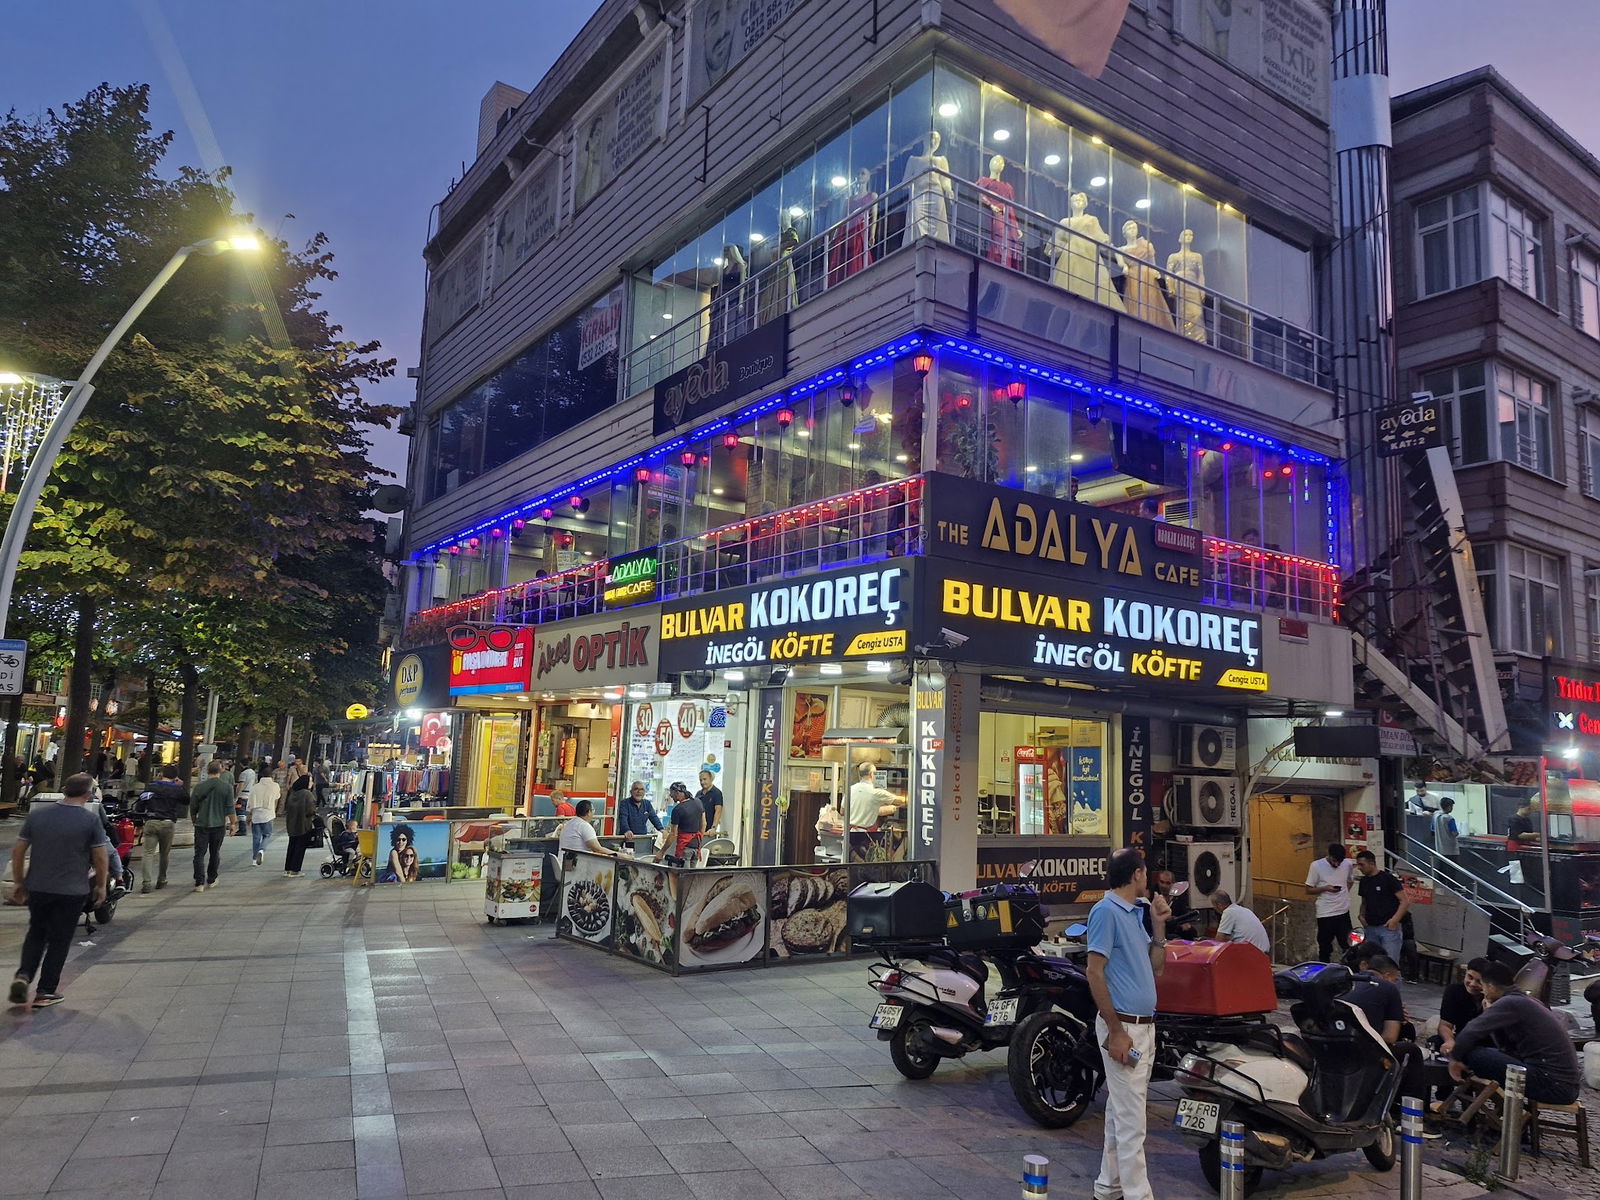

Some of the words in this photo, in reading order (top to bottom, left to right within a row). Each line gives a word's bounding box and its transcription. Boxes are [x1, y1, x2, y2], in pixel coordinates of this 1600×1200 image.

[937, 520, 969, 545] THE
[981, 497, 1142, 576] ADALYA
[1155, 561, 1199, 587] CAFE
[660, 602, 744, 640] BULVAR
[750, 568, 901, 629] KOKOREÇ
[942, 579, 1092, 632] BULVAR
[1104, 597, 1259, 667] KOKOREÇ
[573, 621, 651, 672] OPTİK
[705, 636, 766, 665] İNEGÖL
[770, 632, 835, 660] KÖFTE
[857, 639, 882, 651] Cengiz
[883, 636, 903, 648] USTA
[1033, 634, 1125, 674] İNEGÖL
[1131, 650, 1202, 681] KÖFTE
[1228, 674, 1249, 686] Cengiz
[1249, 676, 1266, 687] USTA
[1557, 676, 1594, 701] Yıldız
[1128, 726, 1145, 821] İNEGÖL
[760, 783, 774, 841] KÖFTE
[976, 863, 1022, 879] ULVA
[1032, 857, 1107, 880] KOKOREÇ
[1043, 880, 1078, 893] KÖFTE
[989, 1001, 1000, 1012] 34
[1001, 999, 1016, 1011] GFK
[993, 1011, 1009, 1022] 676
[880, 1016, 895, 1026] 720
[1180, 1101, 1193, 1113] 34
[1196, 1103, 1218, 1118] FRB
[1184, 1115, 1206, 1129] 726
